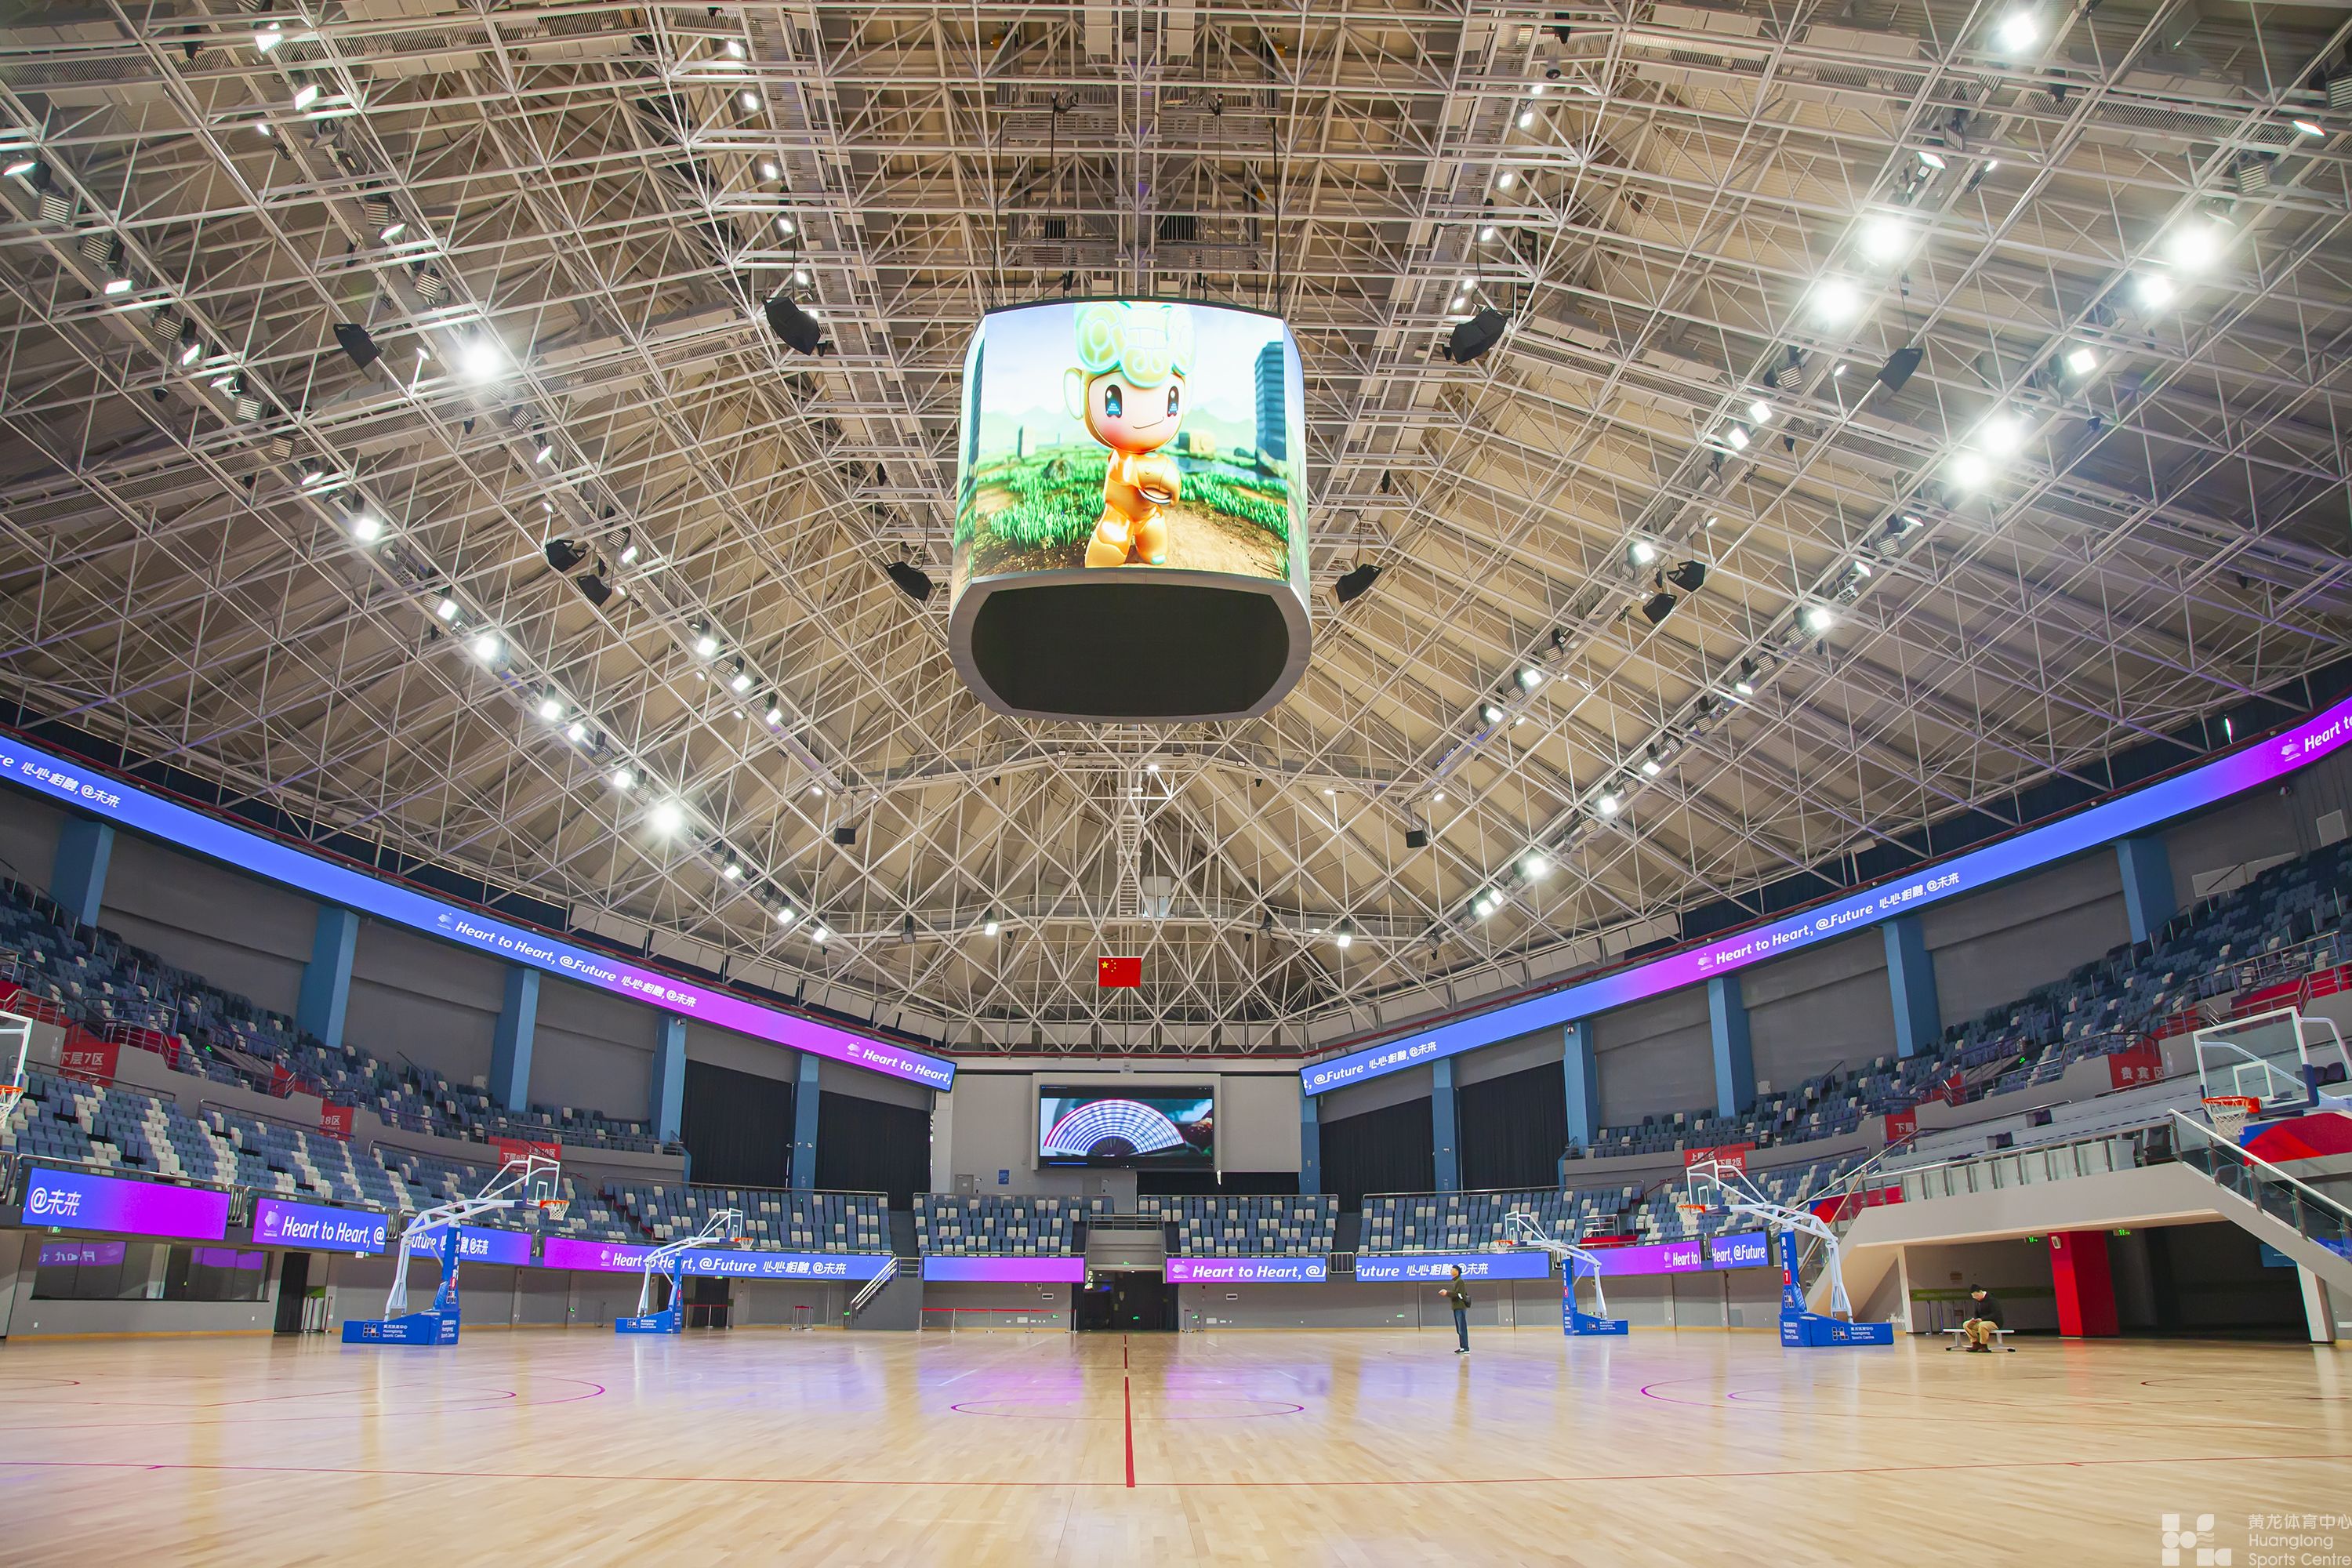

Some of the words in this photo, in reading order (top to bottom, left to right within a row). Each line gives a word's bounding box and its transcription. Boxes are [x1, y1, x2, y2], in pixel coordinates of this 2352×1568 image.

[2304, 721, 2341, 753] Heart
[1715, 943, 1752, 965] Heart
[1755, 938, 1769, 951] to
[1772, 924, 1813, 947] Heart,
[1815, 904, 1874, 931] @Future
[455, 920, 495, 944] Heart
[498, 935, 512, 949] to
[514, 938, 557, 965] Heart,
[559, 956, 617, 982] @Future
[61, 1051, 104, 1065] 下层7区
[862, 1048, 898, 1068] Heart
[901, 1059, 913, 1072] to
[914, 1062, 952, 1085] Heart,
[1313, 1063, 1364, 1086] @Future
[31, 1186, 82, 1216] @未来
[281, 1215, 319, 1240] Heart
[321, 1221, 334, 1241] to
[336, 1221, 371, 1249] Heart,
[612, 1252, 641, 1268] Heart
[659, 1255, 696, 1272] Hert,
[699, 1257, 757, 1272] @Future
[1672, 1251, 1690, 1266] Heart
[1691, 1251, 1698, 1265] to
[1733, 1244, 1766, 1261] @Future
[1192, 1265, 1234, 1278] Heart
[1239, 1266, 1254, 1278] to
[1256, 1265, 1302, 1280] Heart,
